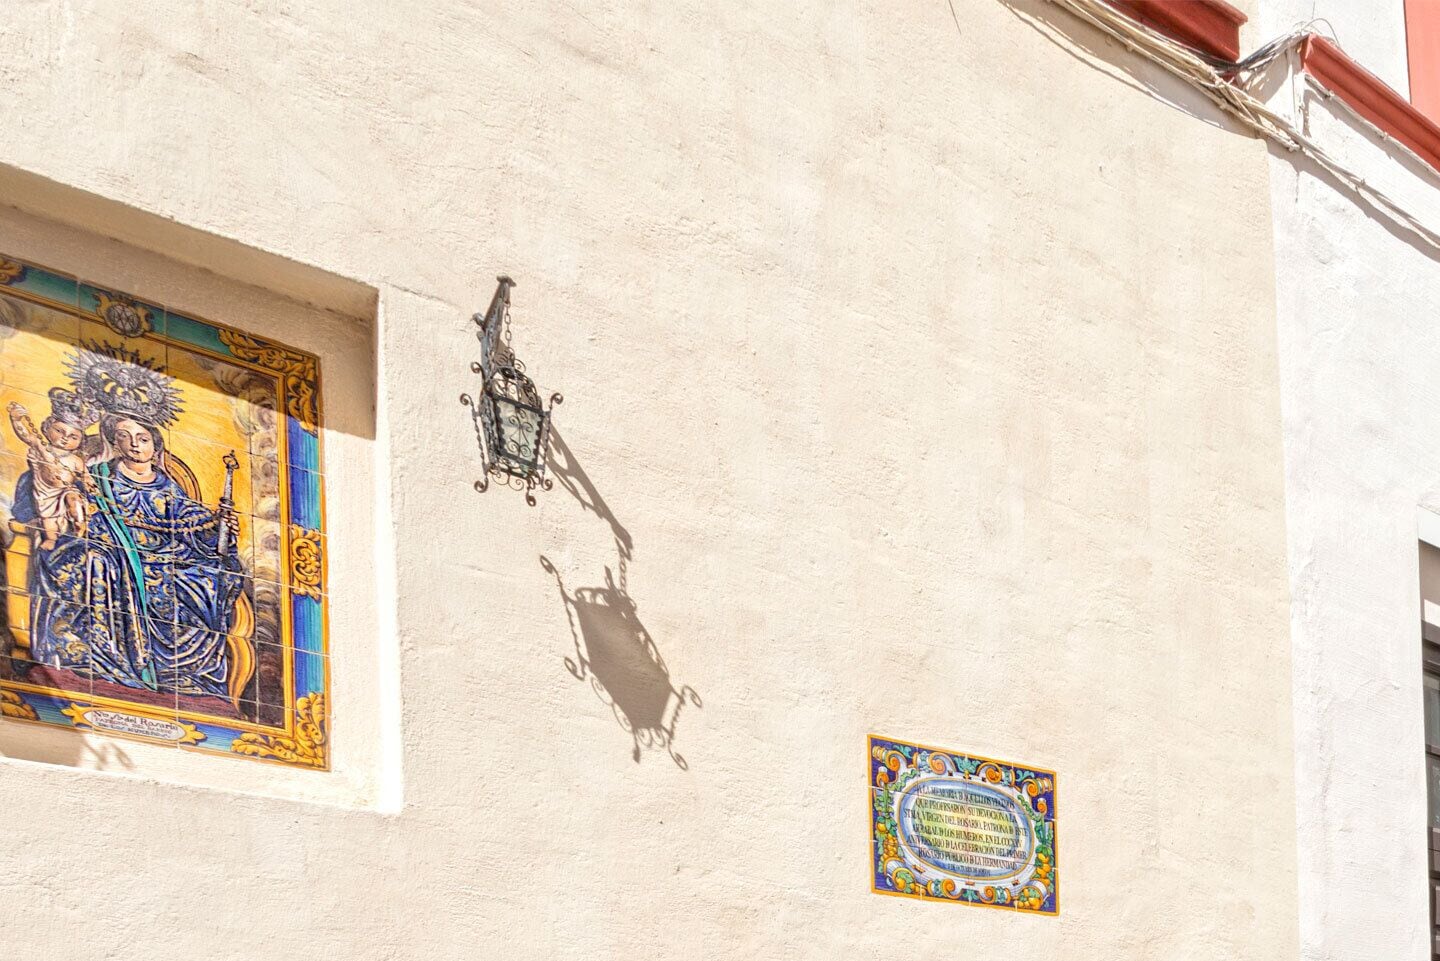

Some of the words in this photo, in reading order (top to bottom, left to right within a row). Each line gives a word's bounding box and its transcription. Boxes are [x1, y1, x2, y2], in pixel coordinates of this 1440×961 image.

[140, 717, 179, 732] Rosario
[916, 797, 928, 809] QUE
[967, 806, 976, 816] SU
[921, 811, 944, 823] VIRGEN
